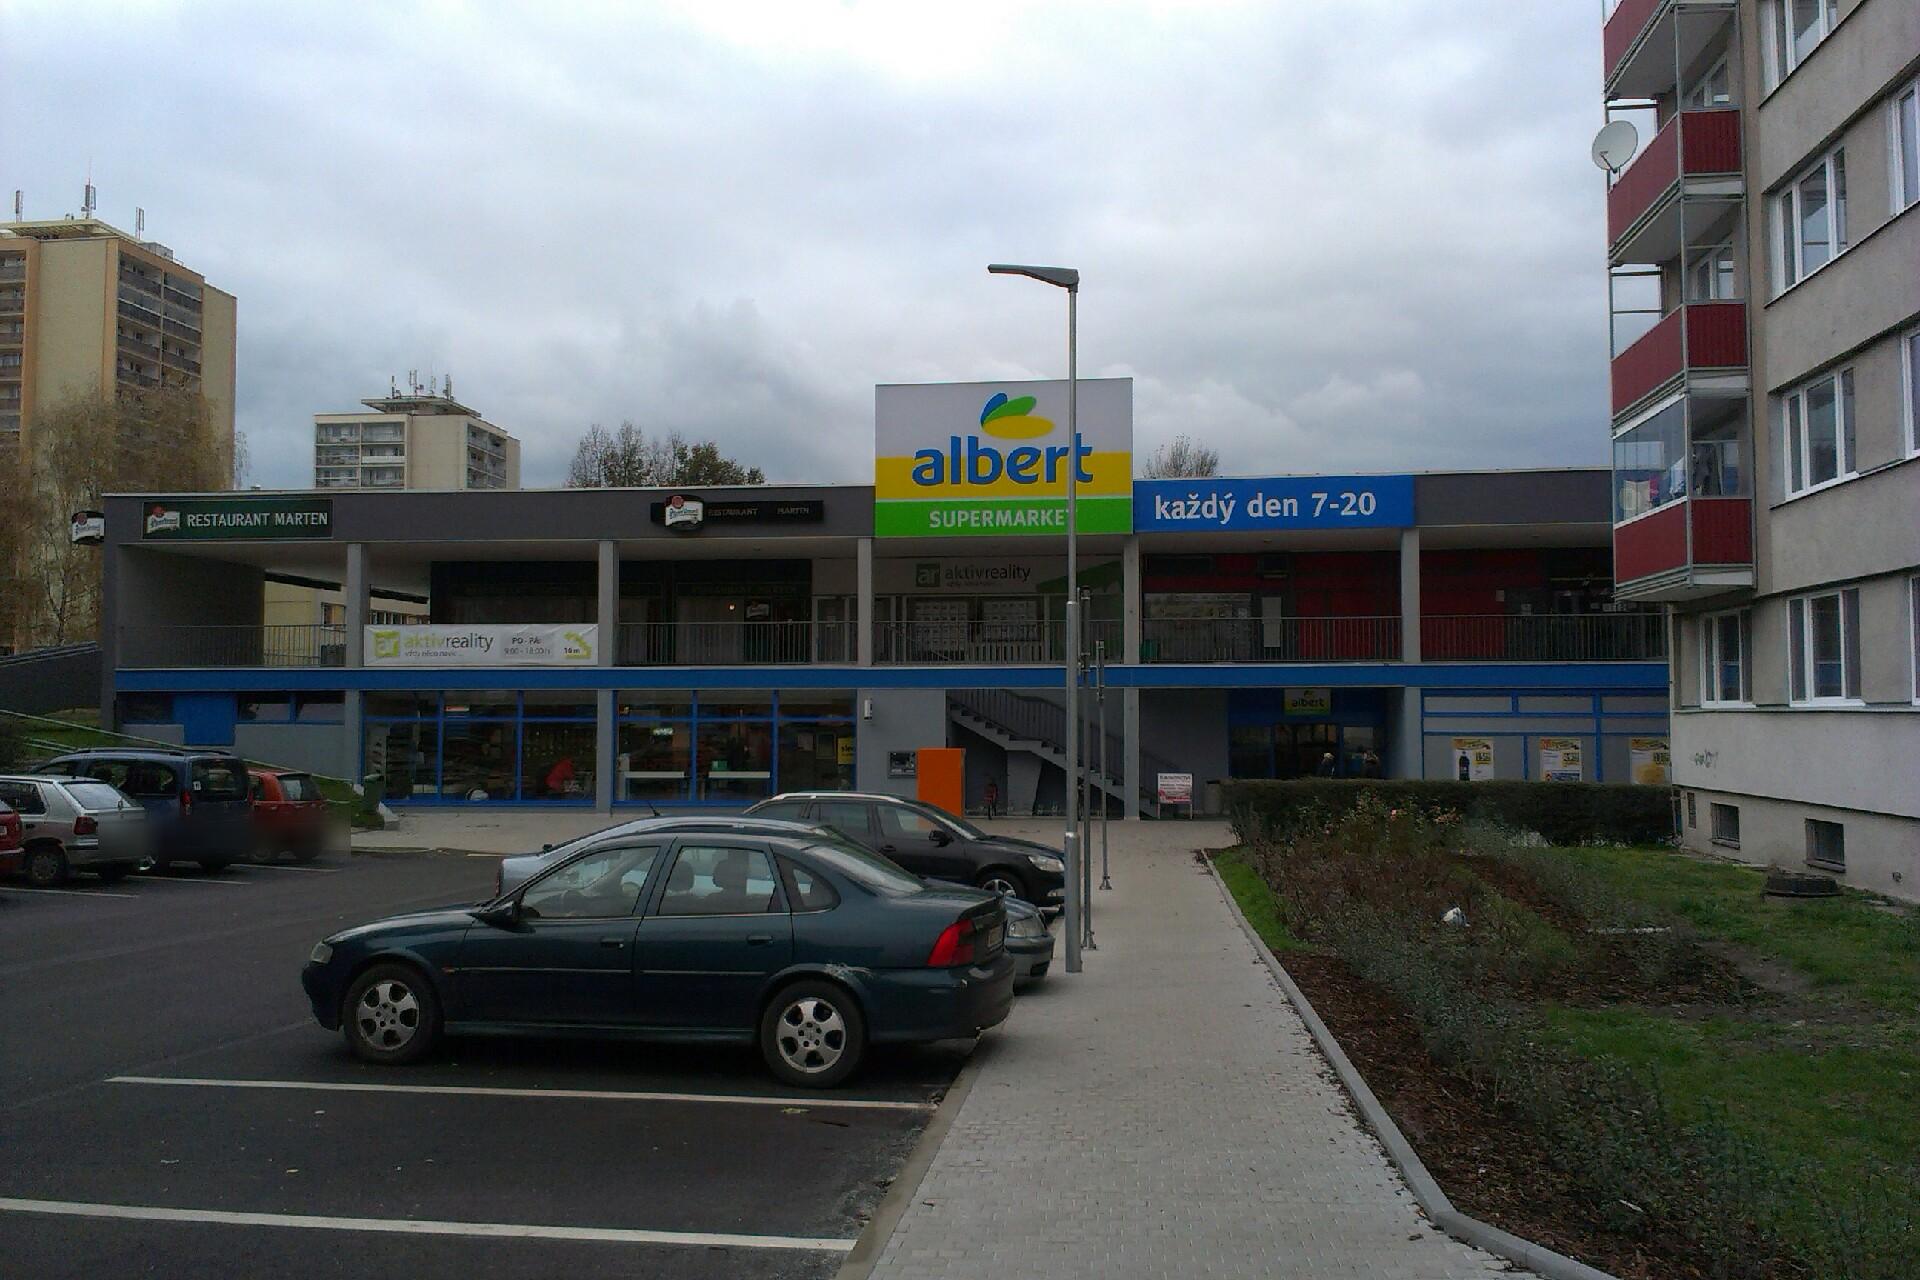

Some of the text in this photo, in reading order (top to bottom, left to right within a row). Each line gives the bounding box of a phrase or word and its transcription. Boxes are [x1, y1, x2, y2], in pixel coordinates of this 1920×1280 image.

[912, 433, 1093, 486] albert
[1155, 491, 1377, 525] každý den 7-20
[187, 513, 270, 527] RESTAURANT
[275, 512, 328, 525] MARTEN
[944, 564, 1031, 582] aktivreality
[403, 632, 494, 653] aktivreality
